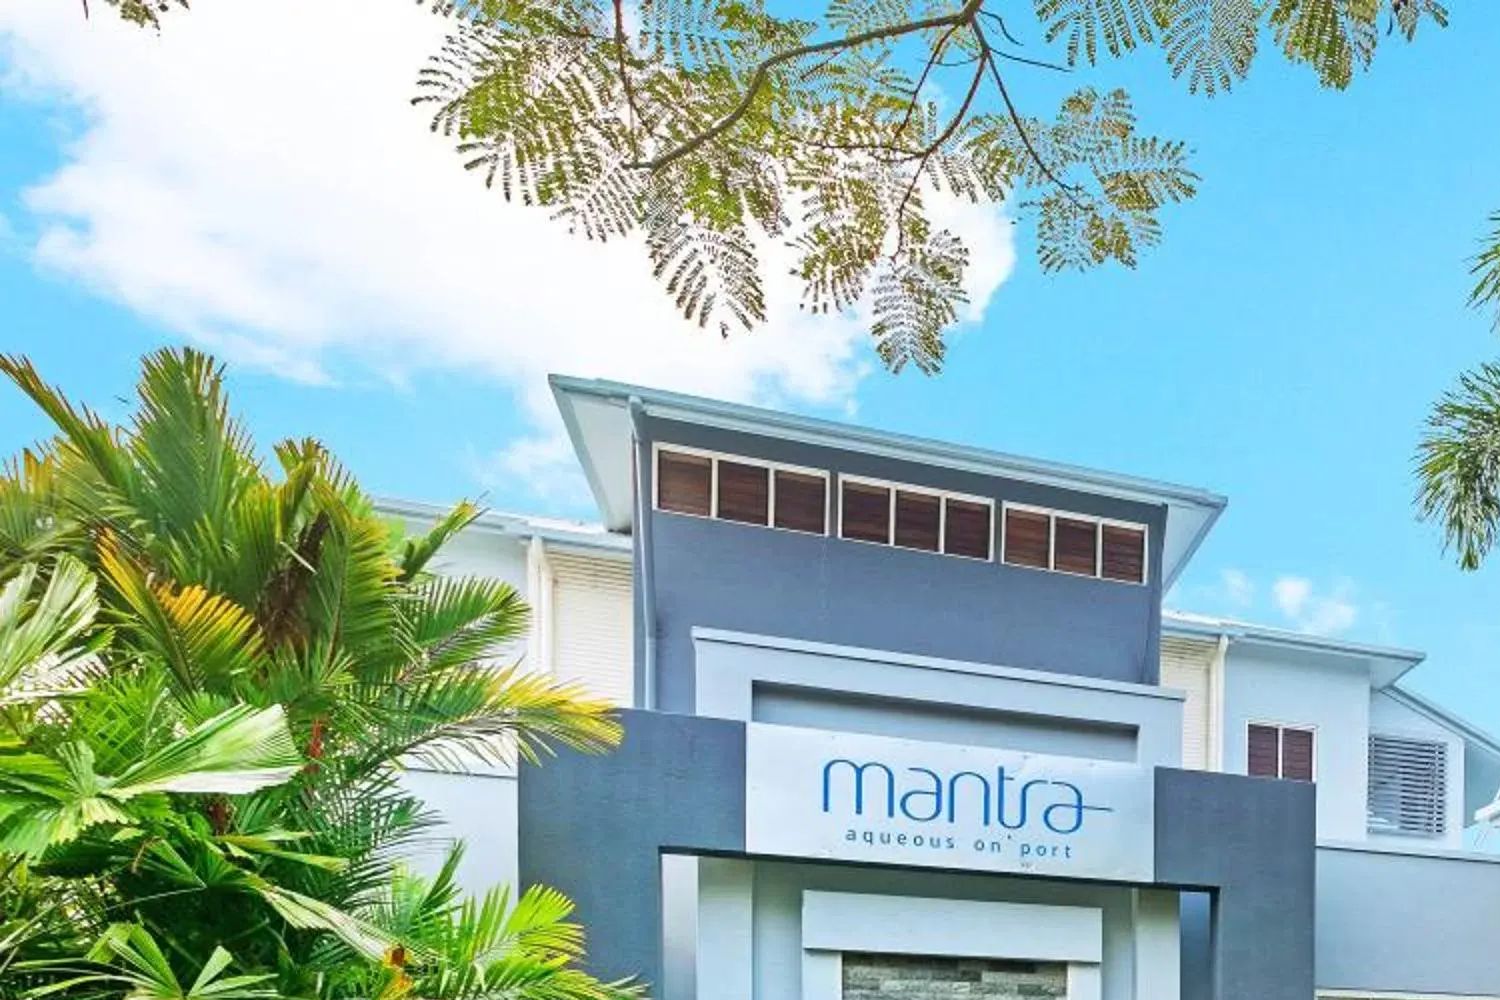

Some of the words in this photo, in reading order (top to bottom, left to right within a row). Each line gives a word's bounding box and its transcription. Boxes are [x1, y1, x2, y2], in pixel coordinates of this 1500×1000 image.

[822, 758, 1114, 834] mantra
[845, 828, 955, 849] aqueous
[973, 838, 1001, 853] on
[1020, 842, 1072, 858] port
